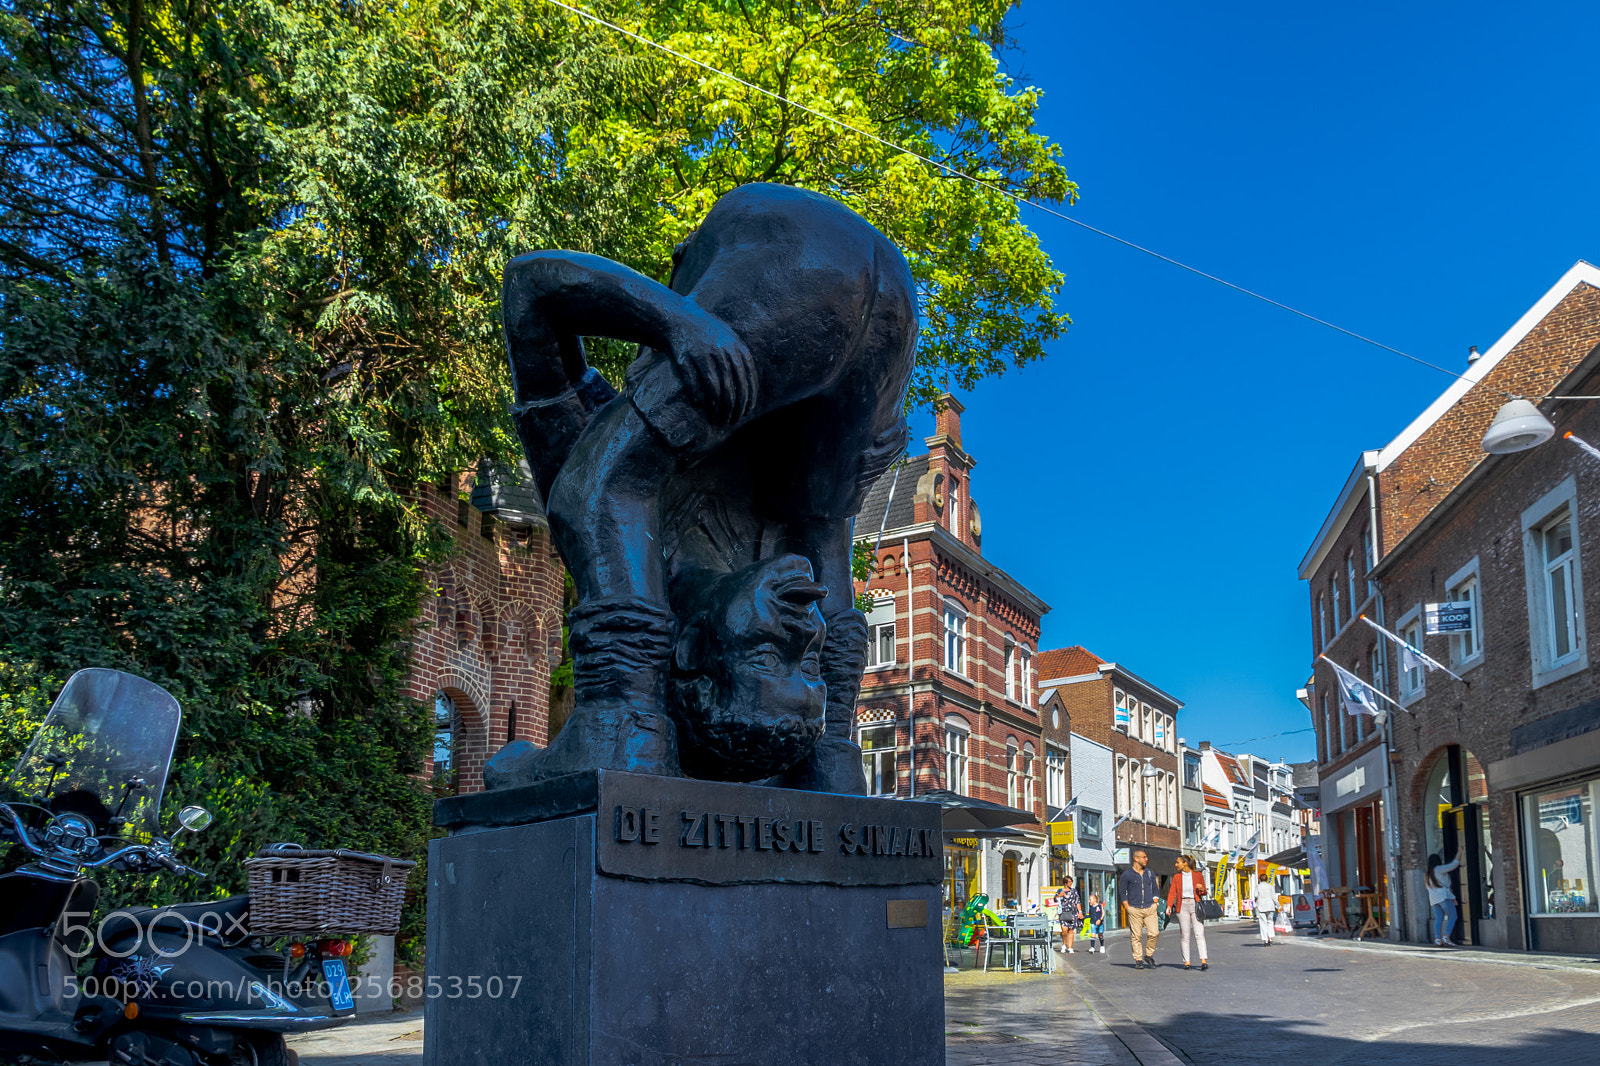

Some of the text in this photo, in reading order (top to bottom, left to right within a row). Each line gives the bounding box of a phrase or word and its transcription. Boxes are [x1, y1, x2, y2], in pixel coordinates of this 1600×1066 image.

[1442, 613, 1469, 622] KOOP
[615, 805, 935, 858] DE ZITTESJE SJNAAK
[325, 964, 343, 978] D29
